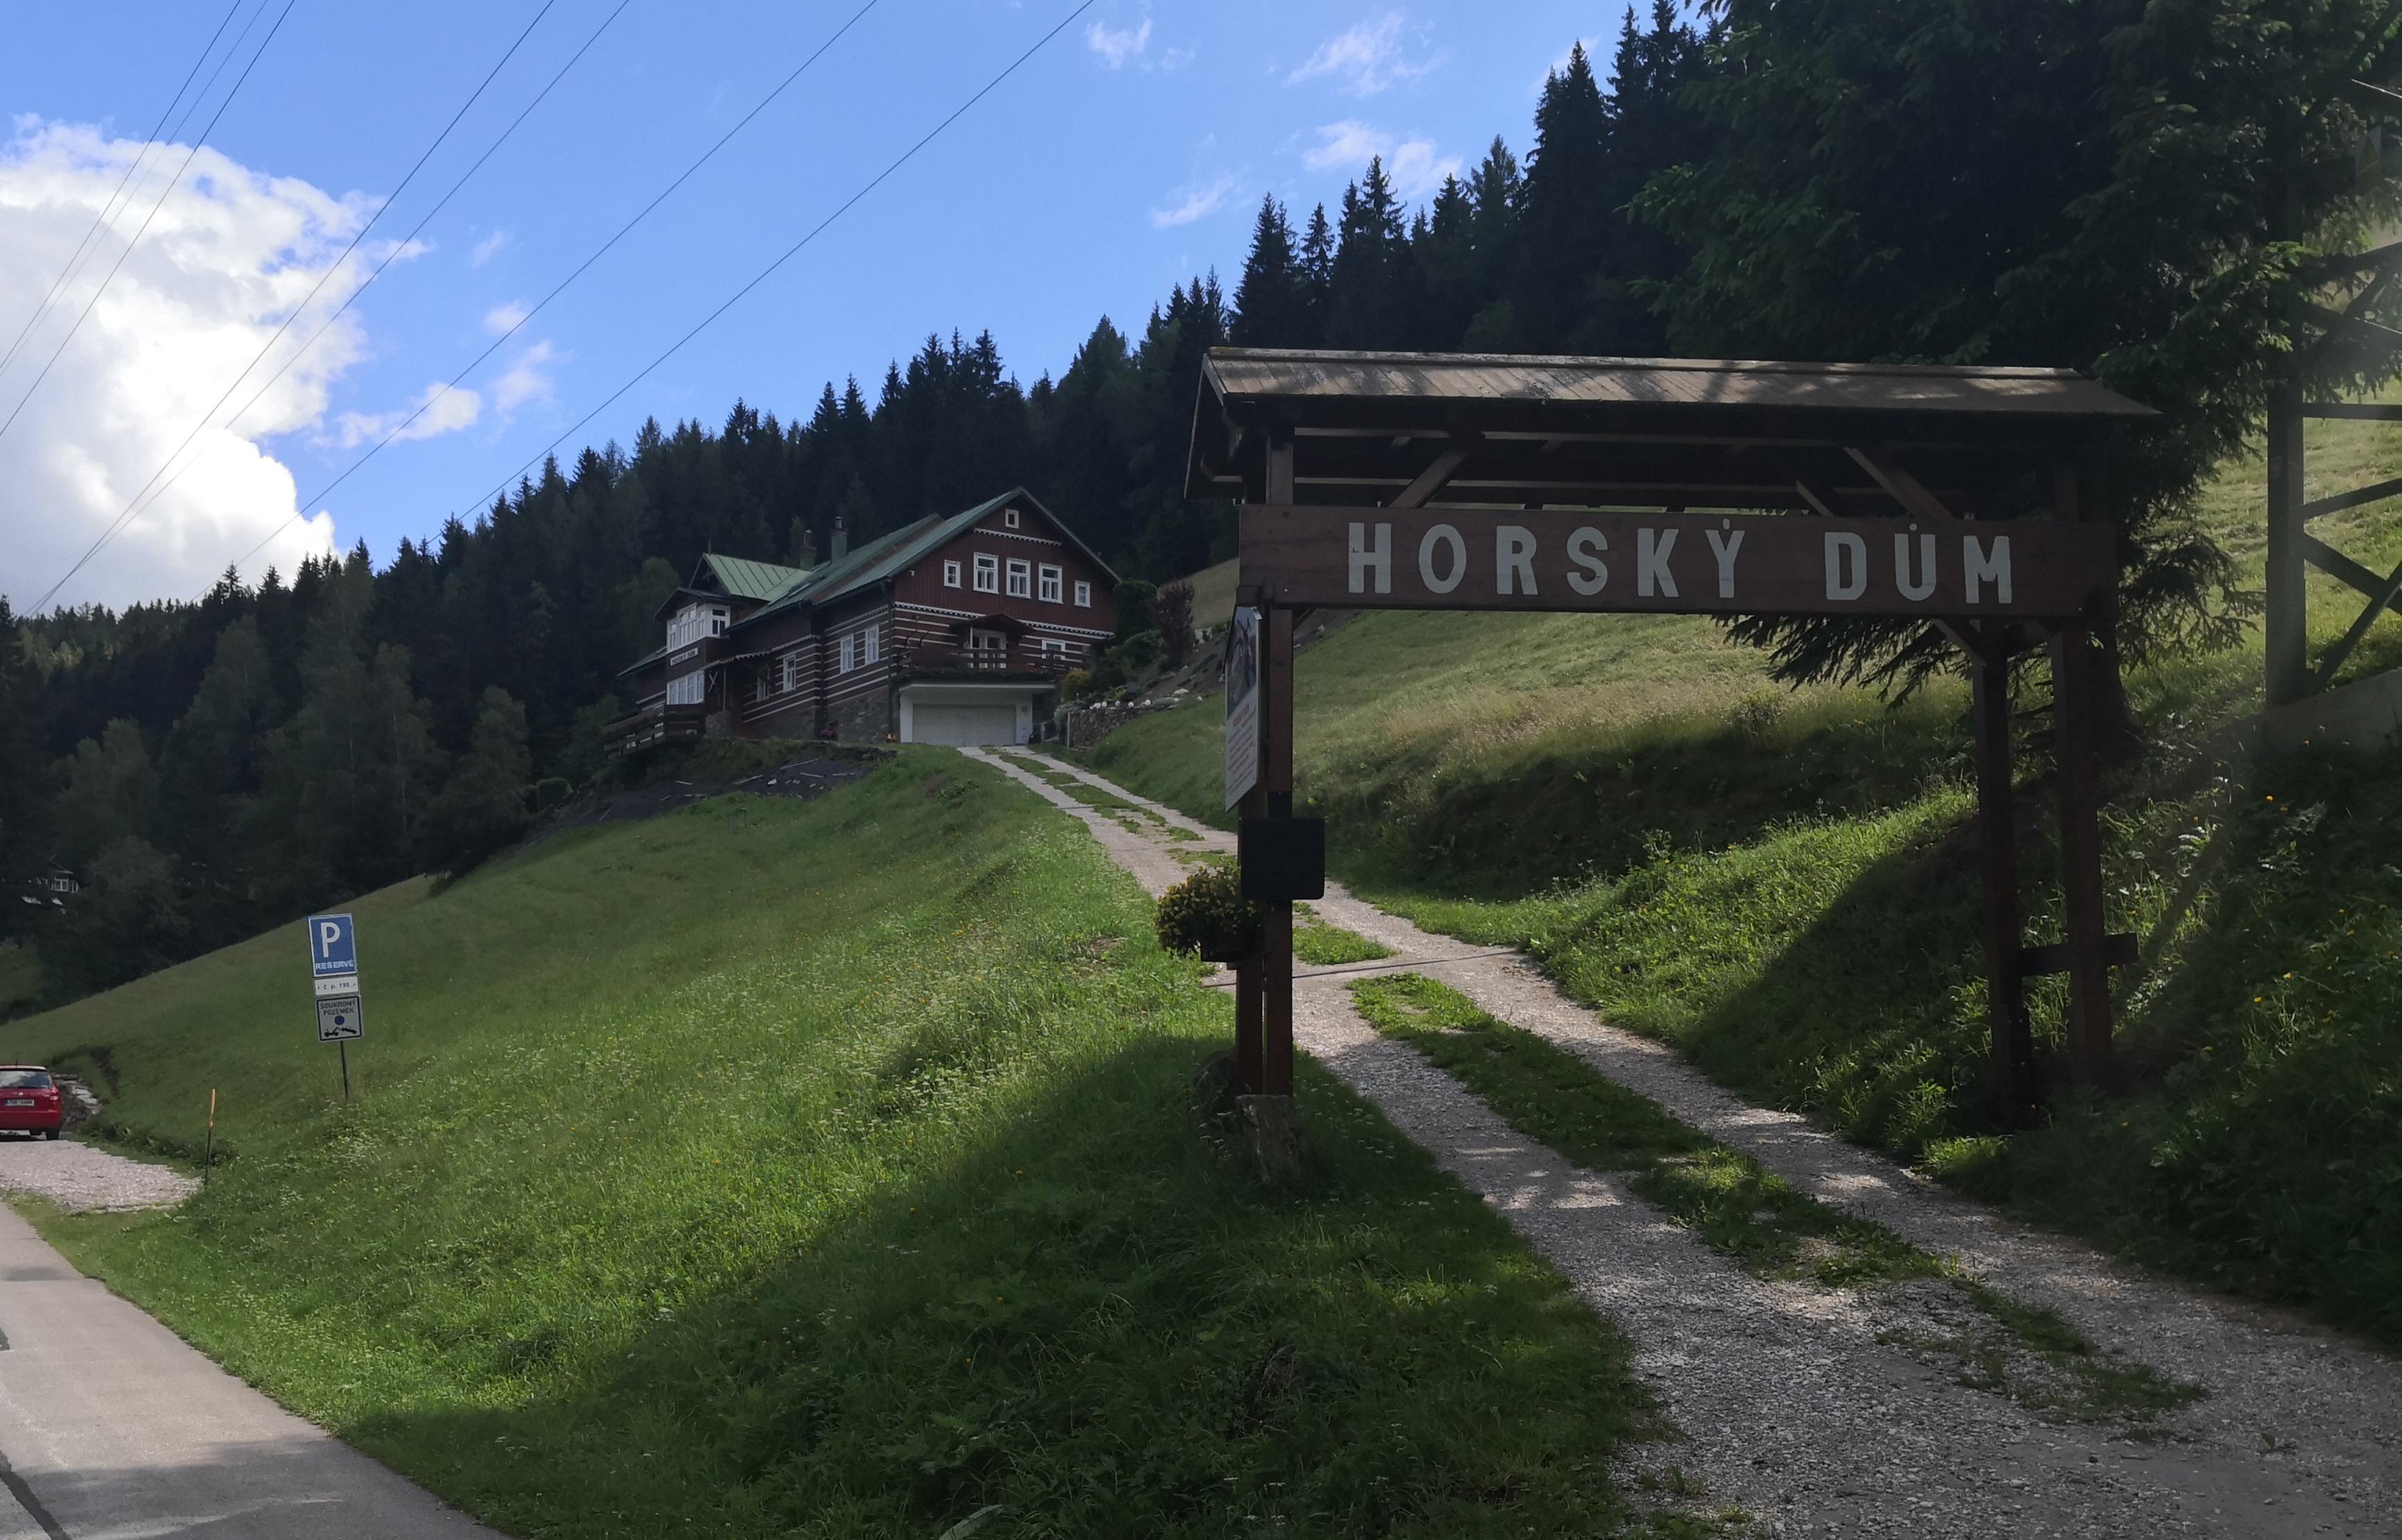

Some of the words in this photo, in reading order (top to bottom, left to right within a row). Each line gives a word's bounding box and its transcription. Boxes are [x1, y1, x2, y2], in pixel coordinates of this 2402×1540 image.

[1348, 518, 1746, 599] HORSKÝ
[1824, 523, 2012, 604] DŮM
[320, 922, 340, 958] P
[315, 958, 354, 970] RESERVÉ
[320, 999, 355, 1009] SOUKROMÝ
